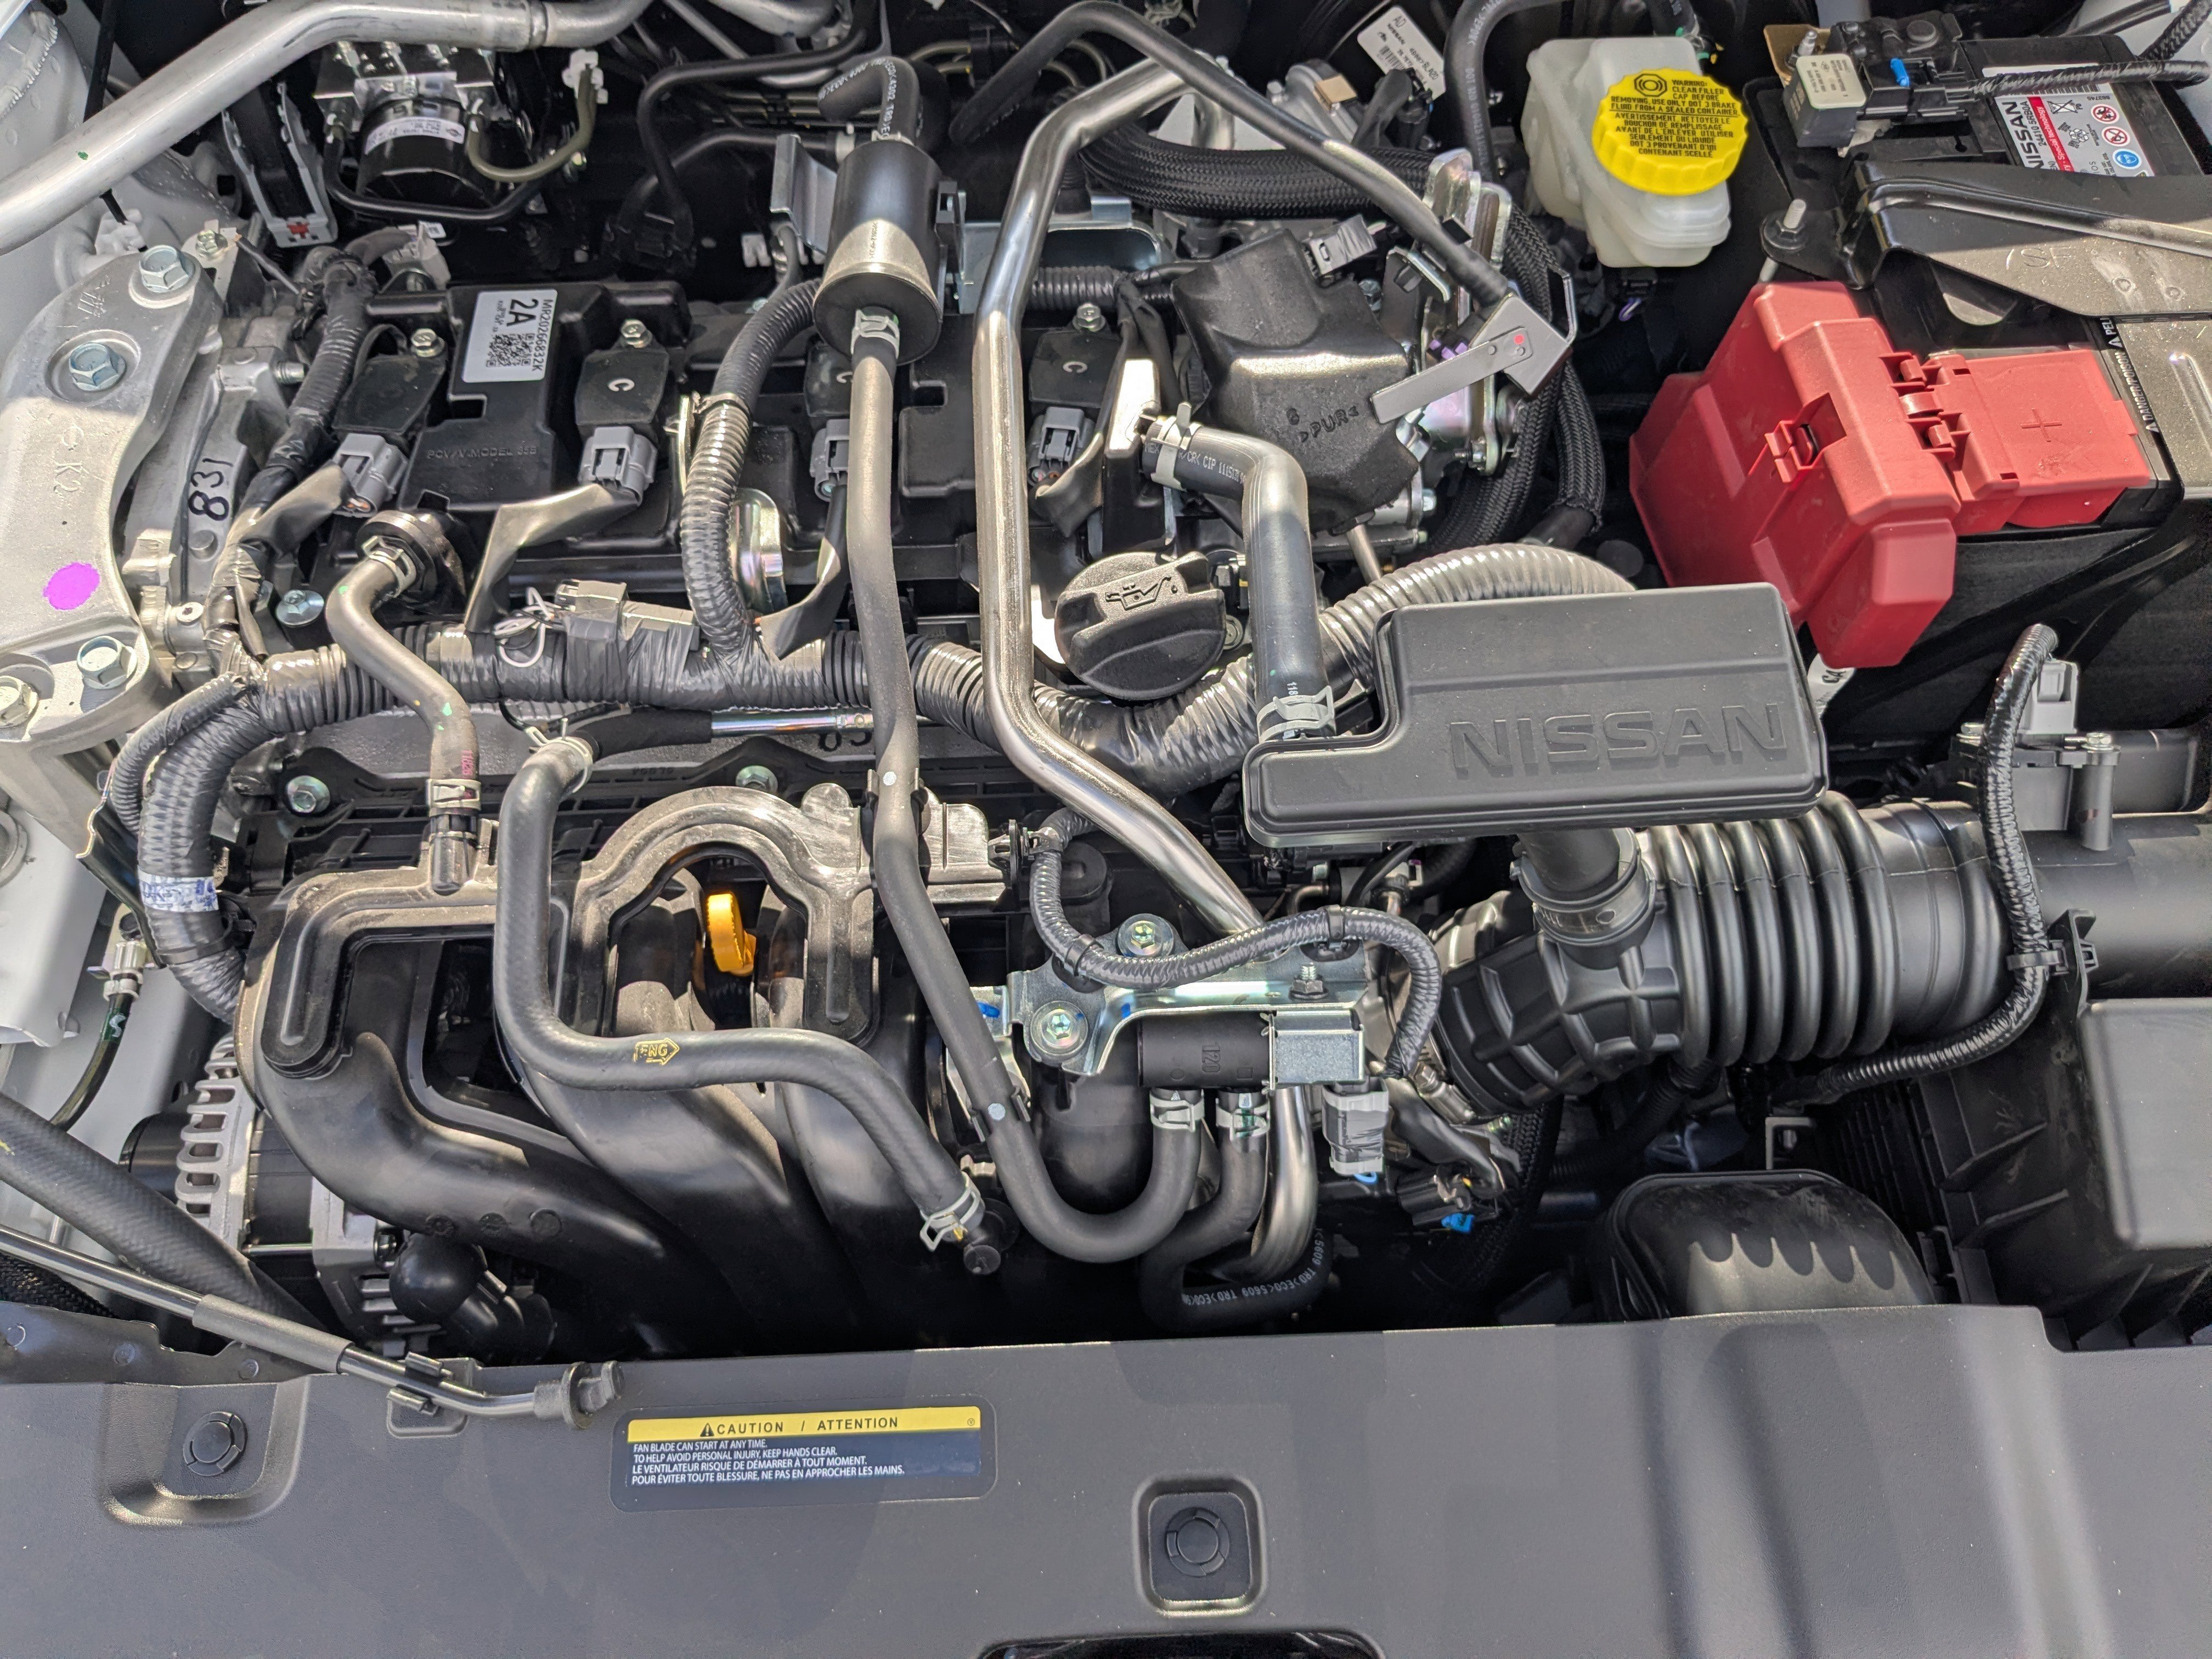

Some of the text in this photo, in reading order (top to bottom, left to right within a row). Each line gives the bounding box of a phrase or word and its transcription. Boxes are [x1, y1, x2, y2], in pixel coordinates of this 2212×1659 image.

[1671, 122, 1723, 131] REMPLISSAGE
[2036, 105, 2056, 139] technology
[1638, 148, 1682, 156] CONTENANT
[1653, 142, 1697, 150] PROVENANT
[2051, 137, 2066, 161] Special
[506, 298, 539, 327] 2A
[532, 299, 554, 371] MR20266832K
[2114, 350, 2154, 421] DANGER/POISON
[188, 458, 234, 521] 831
[1450, 703, 1787, 779] NISSAN
[639, 1043, 668, 1057] ENG
[1201, 1042, 1221, 1073] 120
[716, 1421, 783, 1435] CAUTION
[817, 1417, 898, 1431] ATTENTION
[633, 1438, 768, 1453] FAN BLADE CAN START AT ANY TIME.
[634, 1446, 838, 1463] TO HELP AVOID PERSONAL INJURY, KEEP HANDS CLEAR.
[632, 1464, 905, 1485] POUR ÉVITER TOUTE BLESSURE, NE PAS EN APPROCHER LES MAINS.
[633, 1455, 867, 1474] LE VENTILATEUR RISQUE DE DÉMARRER À TOUT MOMENT.
